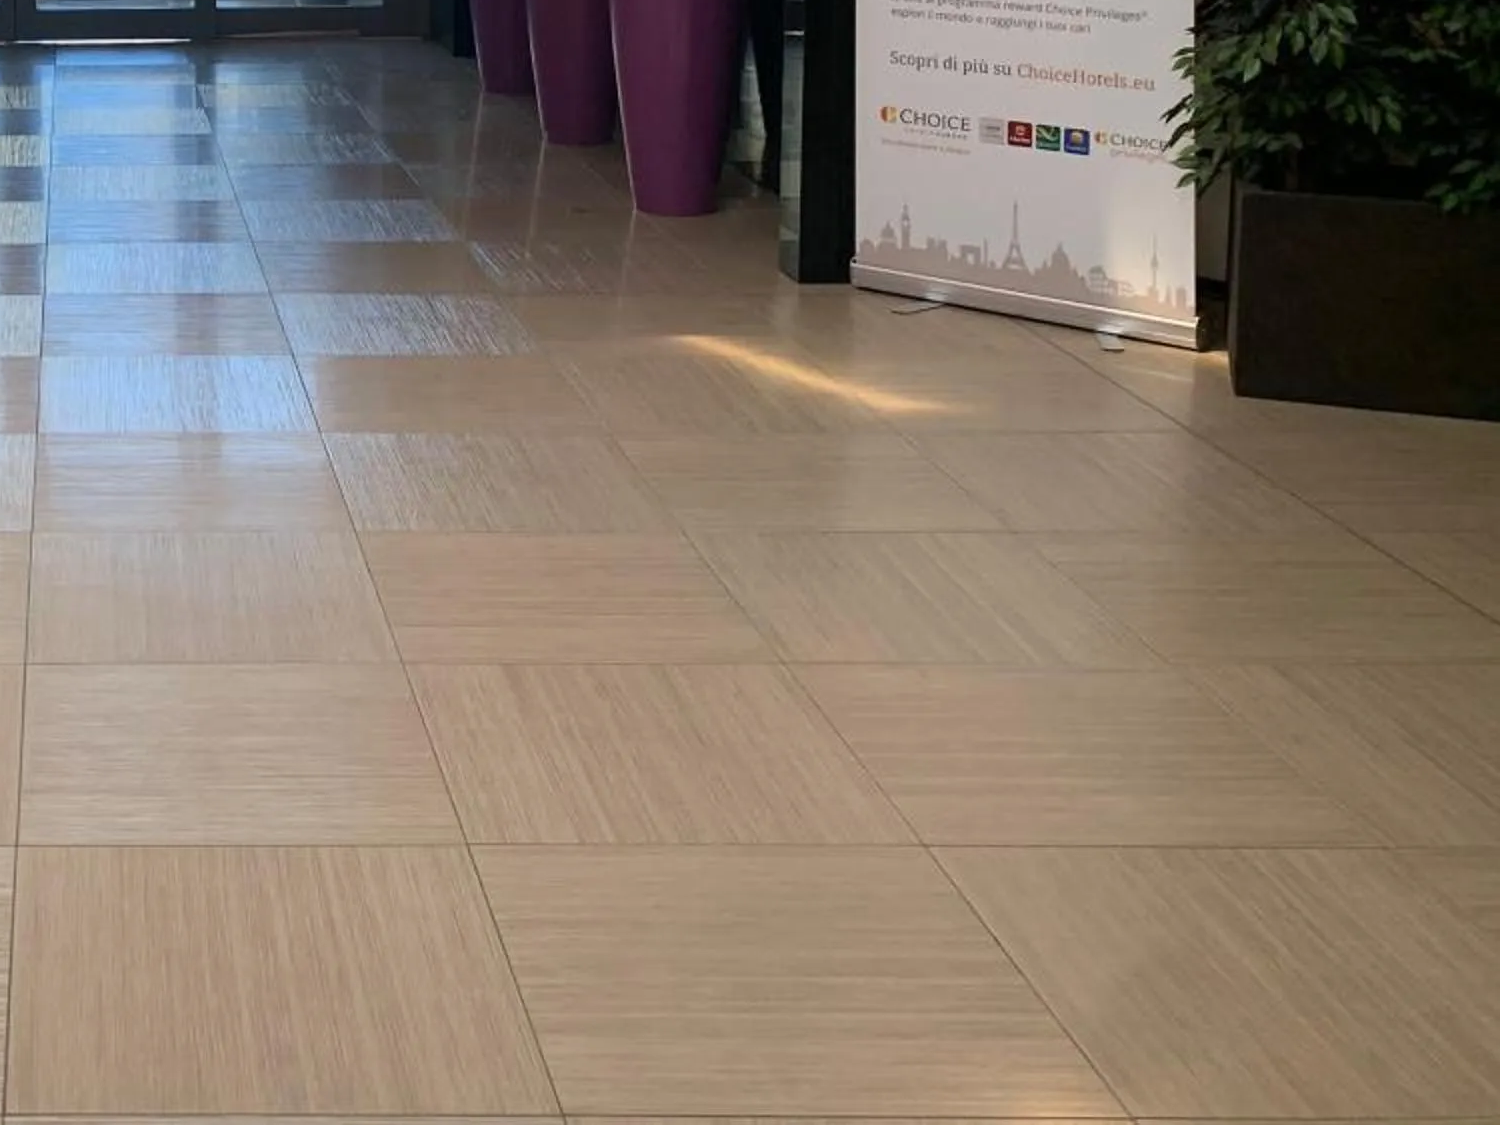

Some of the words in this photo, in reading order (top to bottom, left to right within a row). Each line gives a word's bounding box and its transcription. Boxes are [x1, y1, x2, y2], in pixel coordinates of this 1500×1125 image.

[936, 11, 974, 23] mondo
[1045, 3, 1083, 15] Choice
[889, 50, 939, 72] Scopri
[943, 55, 957, 72] di
[962, 58, 989, 76] più
[993, 62, 1011, 76] su
[1017, 62, 1156, 92] ChoiceHotels.eu
[899, 108, 972, 133] CHOICE
[1109, 133, 1169, 152] CHOICE
